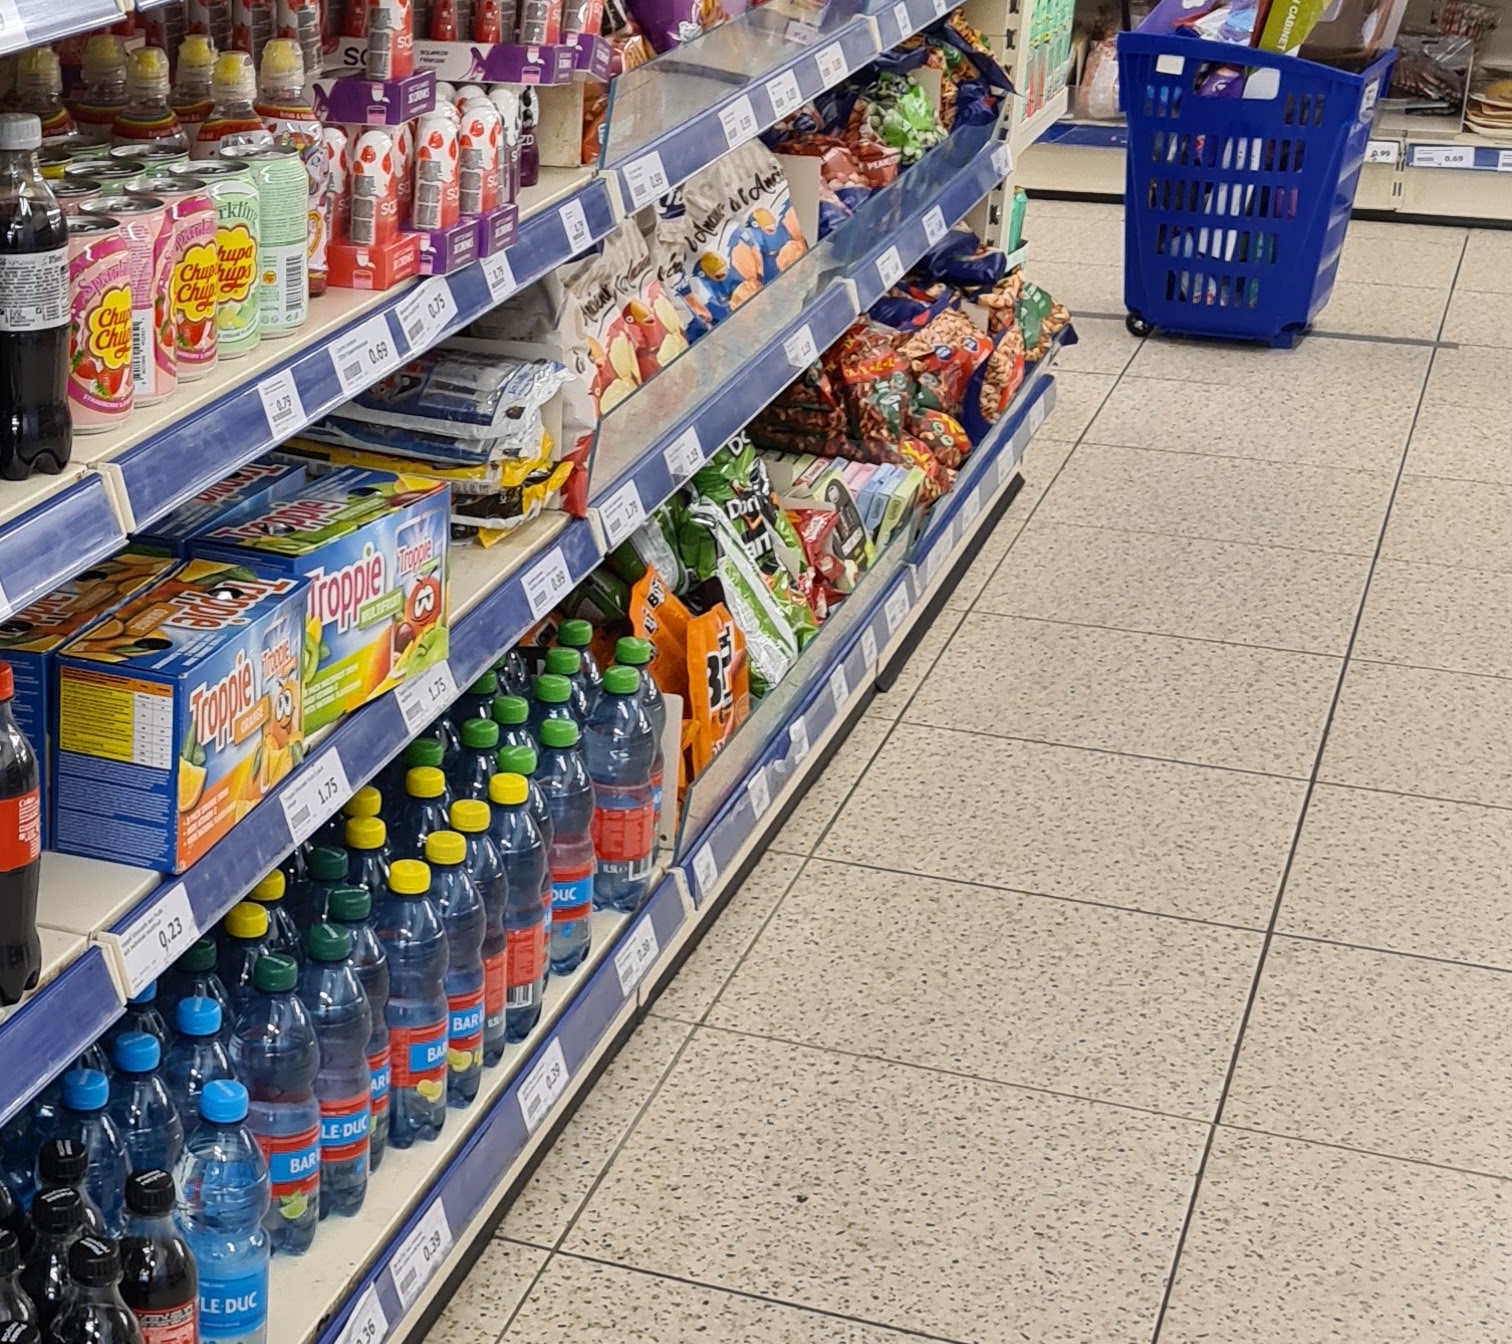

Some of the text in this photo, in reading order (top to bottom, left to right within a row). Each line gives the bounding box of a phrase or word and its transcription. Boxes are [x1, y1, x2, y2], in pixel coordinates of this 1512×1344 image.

[368, 341, 388, 365] 0.69
[306, 542, 385, 633] Troppie
[172, 578, 300, 631] Troppie
[191, 652, 255, 752] Troppie
[427, 677, 447, 703] 1.75
[316, 776, 339, 805] 1.75
[158, 916, 183, 949] 0.23
[423, 1229, 442, 1262] 0.39
